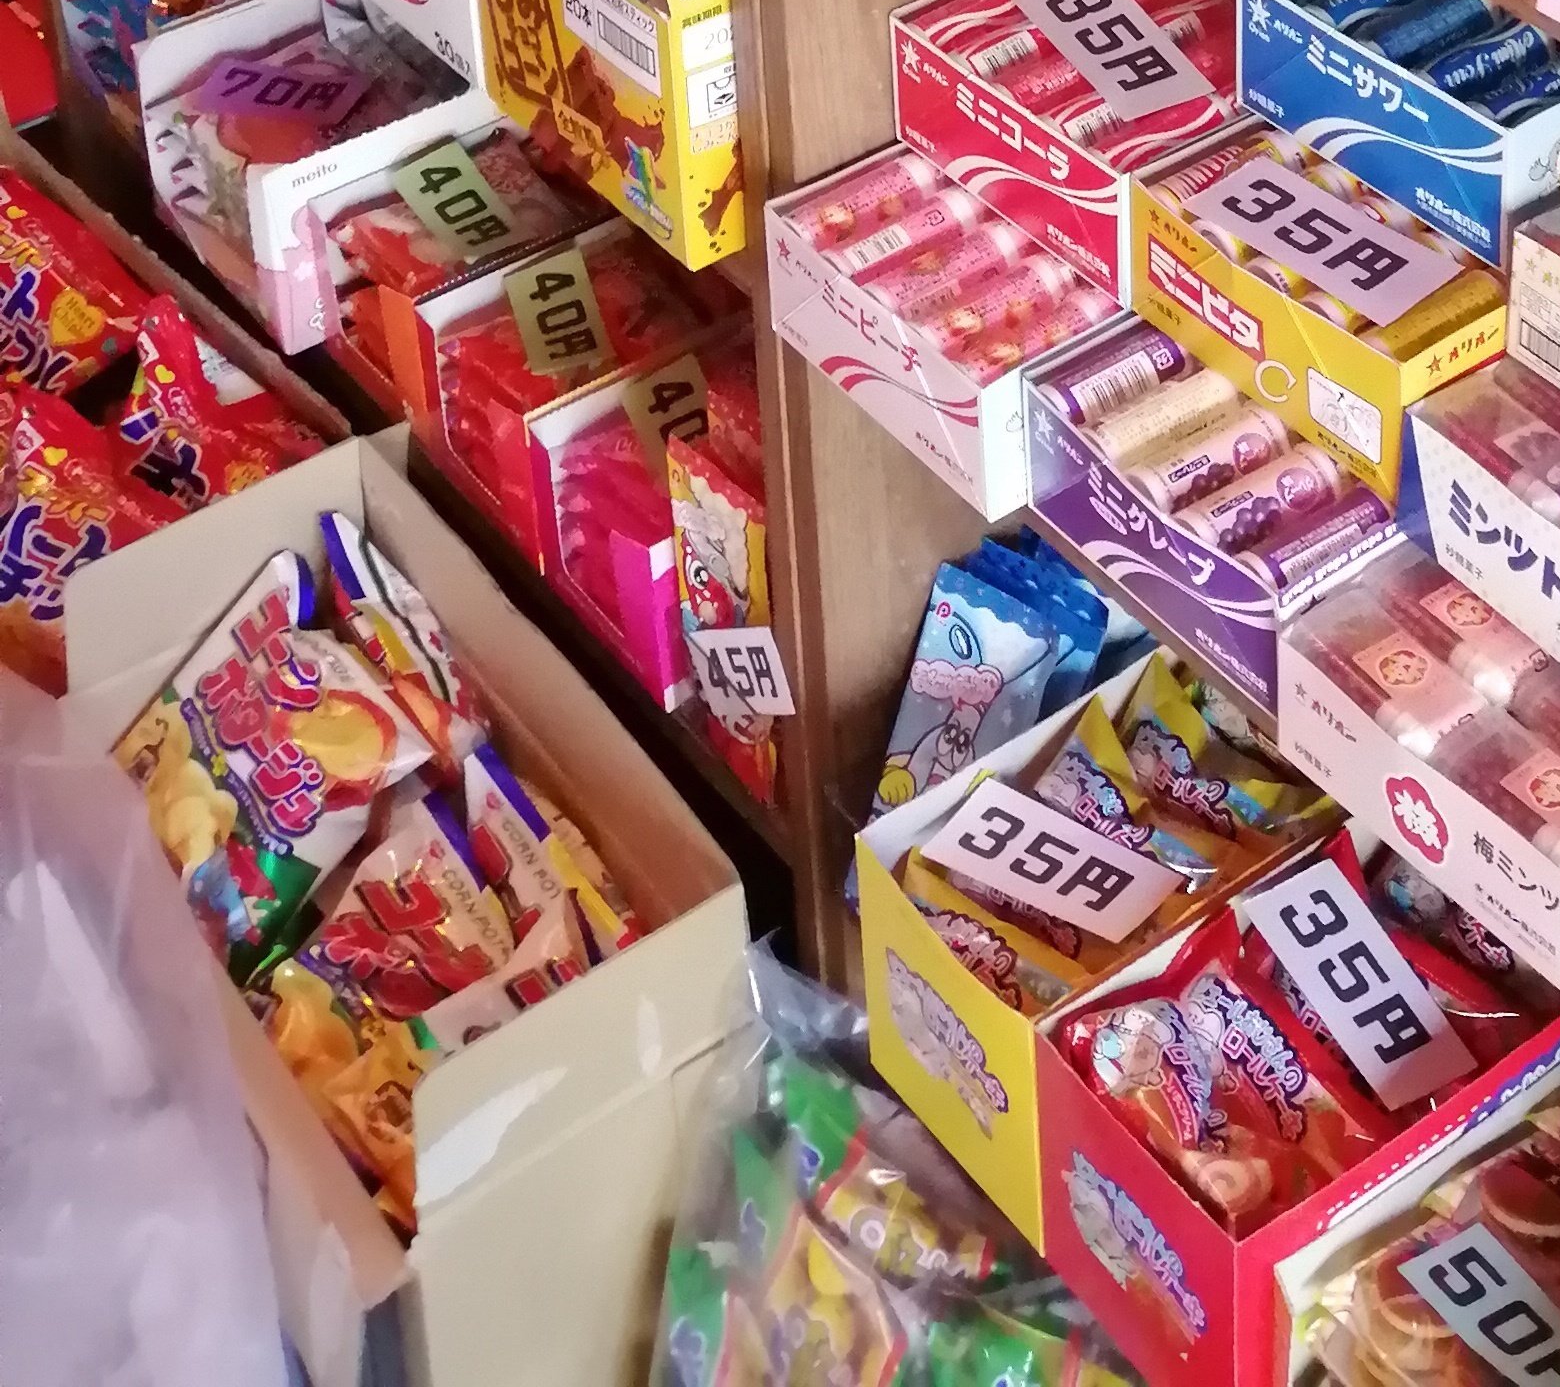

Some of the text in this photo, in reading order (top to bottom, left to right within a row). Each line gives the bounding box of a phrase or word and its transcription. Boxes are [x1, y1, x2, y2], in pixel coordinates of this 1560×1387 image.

[222, 65, 350, 114] 70円
[1306, 33, 1430, 123] ミニサワー
[291, 160, 339, 189] meito
[955, 83, 1070, 181] ミニコーラ
[417, 161, 511, 249] 40円
[1223, 179, 1409, 291] 35円
[531, 272, 599, 360] 40円
[1150, 244, 1261, 351] ミニビタ
[1254, 358, 1297, 404] C
[1448, 325, 1500, 366] オリオン
[1087, 460, 1217, 587] ミニグレープ
[706, 648, 778, 701] 45円
[1311, 697, 1358, 744] オリオン
[502, 819, 538, 865] CORN
[958, 805, 1135, 913] 35円
[1472, 830, 1560, 911] 梅ミンツ
[441, 868, 478, 917] CORN
[1280, 888, 1432, 1061] 35円
